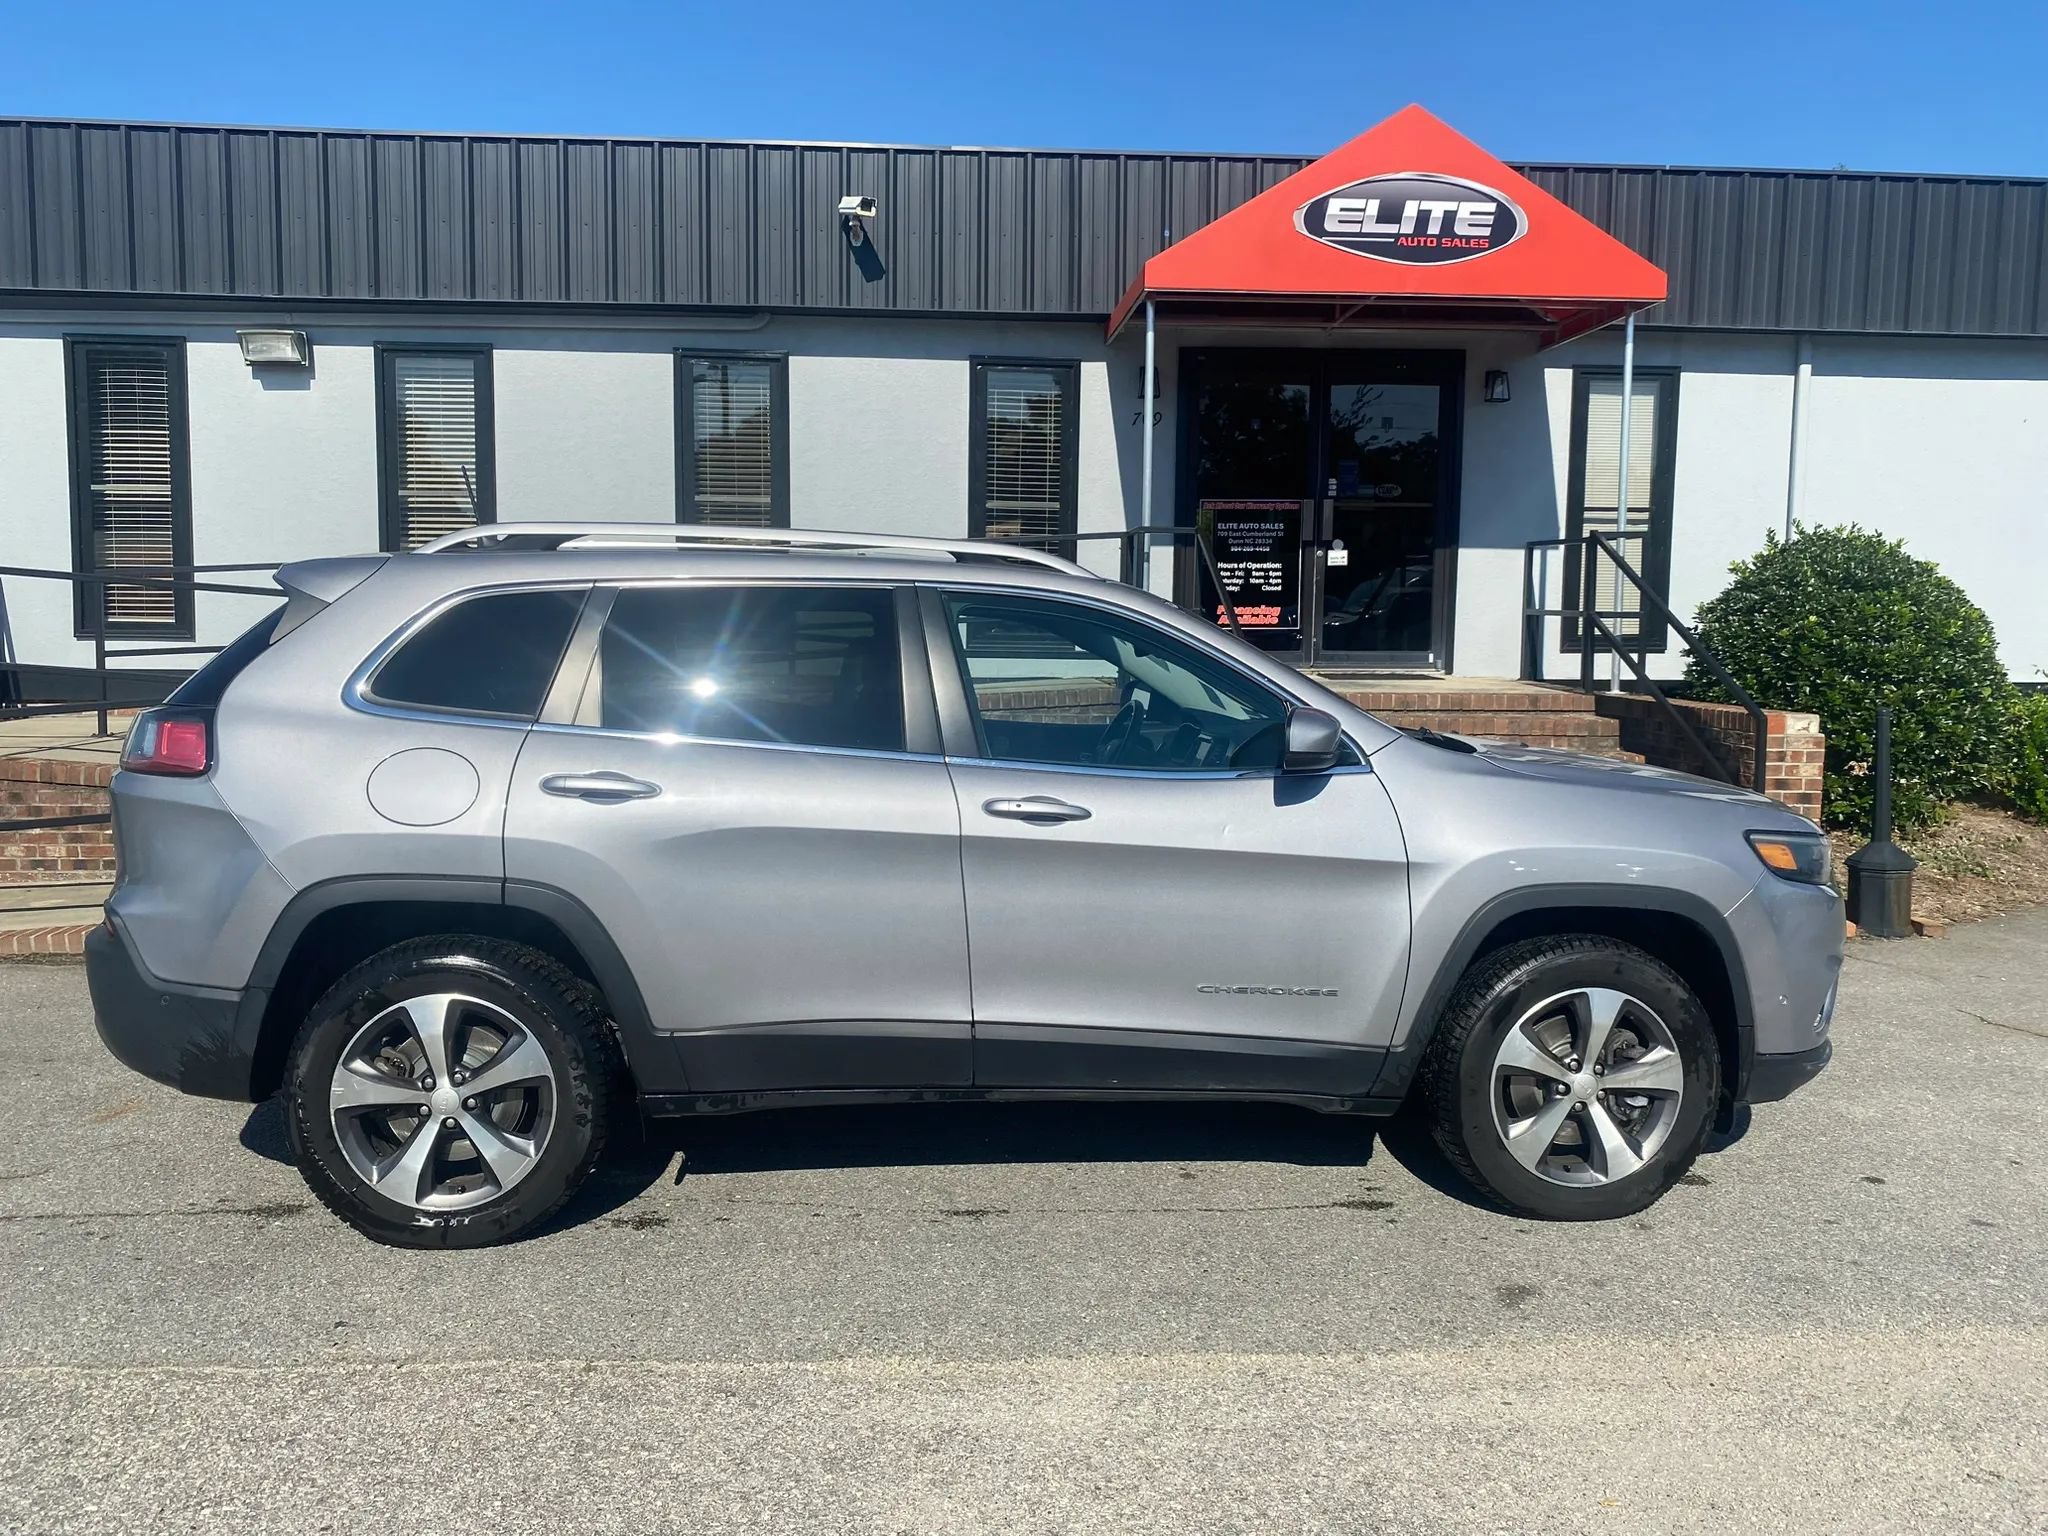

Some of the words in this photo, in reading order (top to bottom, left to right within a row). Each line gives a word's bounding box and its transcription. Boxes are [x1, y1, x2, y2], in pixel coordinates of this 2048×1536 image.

[1323, 197, 1498, 237] ELITE
[1397, 237, 1437, 247] AUTO
[1441, 238, 1490, 249] SALES
[1131, 411, 1163, 427] 79
[1247, 562, 1282, 570] Operation:
[1196, 983, 1340, 997] CHEROKEE
